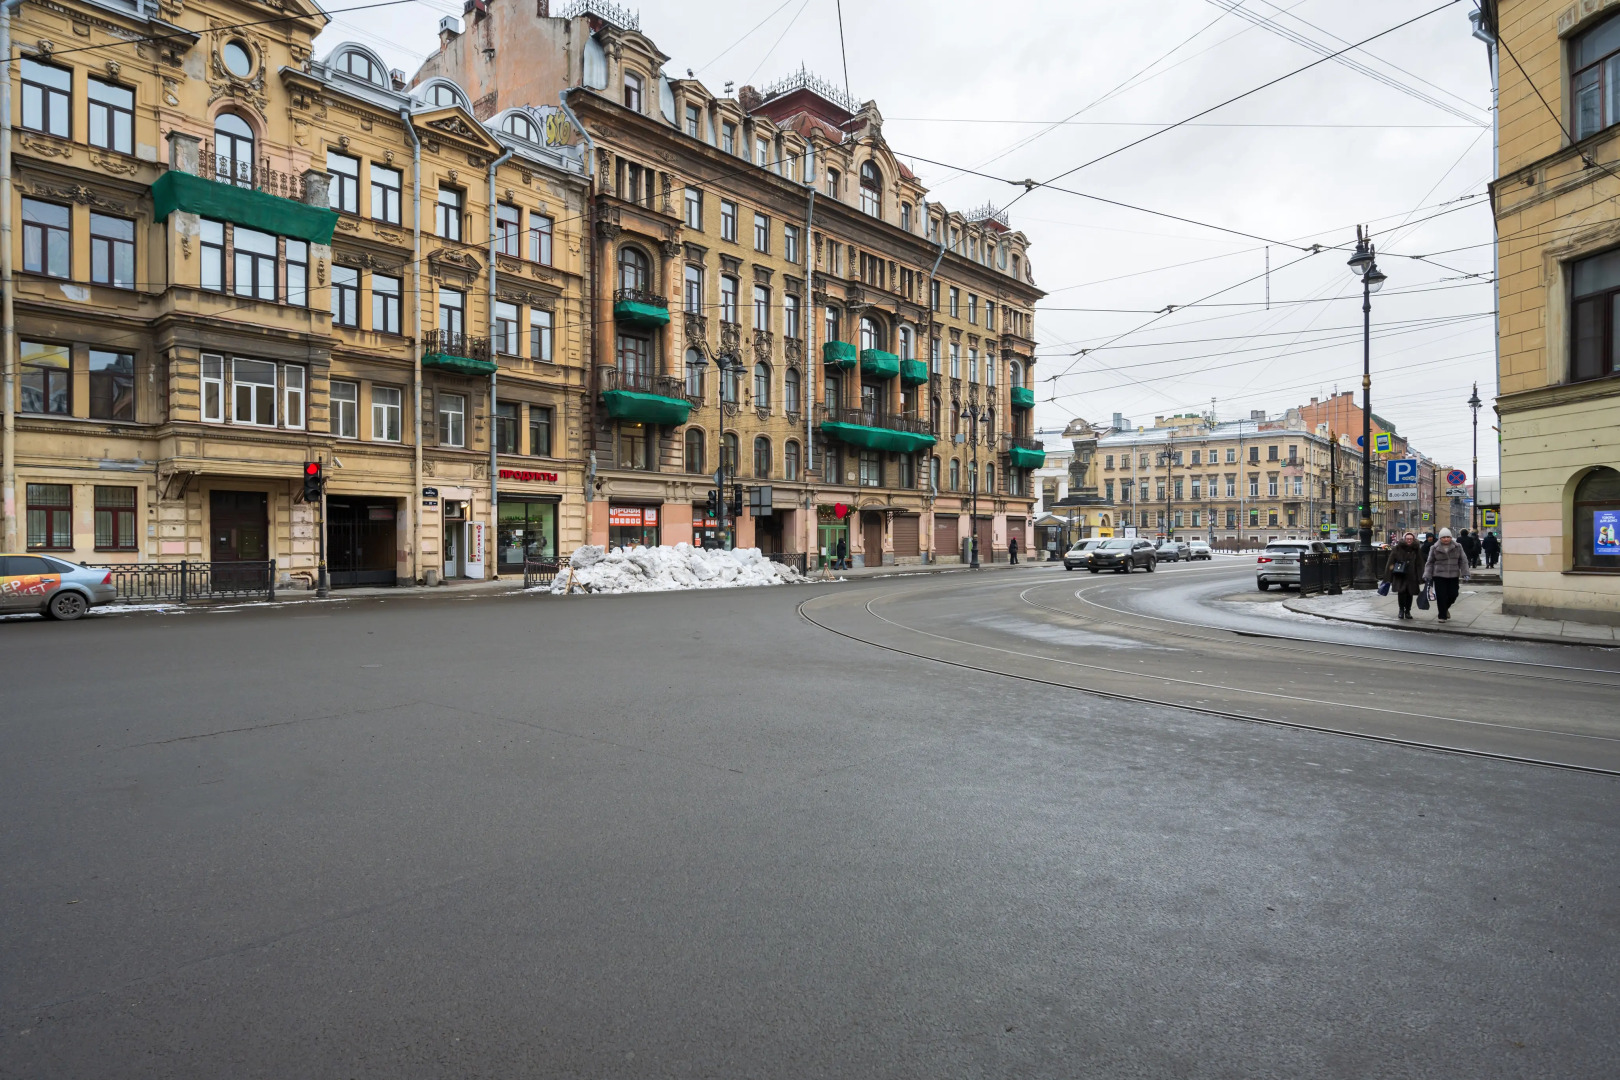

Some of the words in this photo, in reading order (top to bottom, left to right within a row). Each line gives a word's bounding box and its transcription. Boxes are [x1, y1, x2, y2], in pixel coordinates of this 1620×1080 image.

[499, 469, 558, 481] ПРОДУКТЫ
[1395, 462, 1412, 482] P
[0, 580, 21, 594] ЕР
